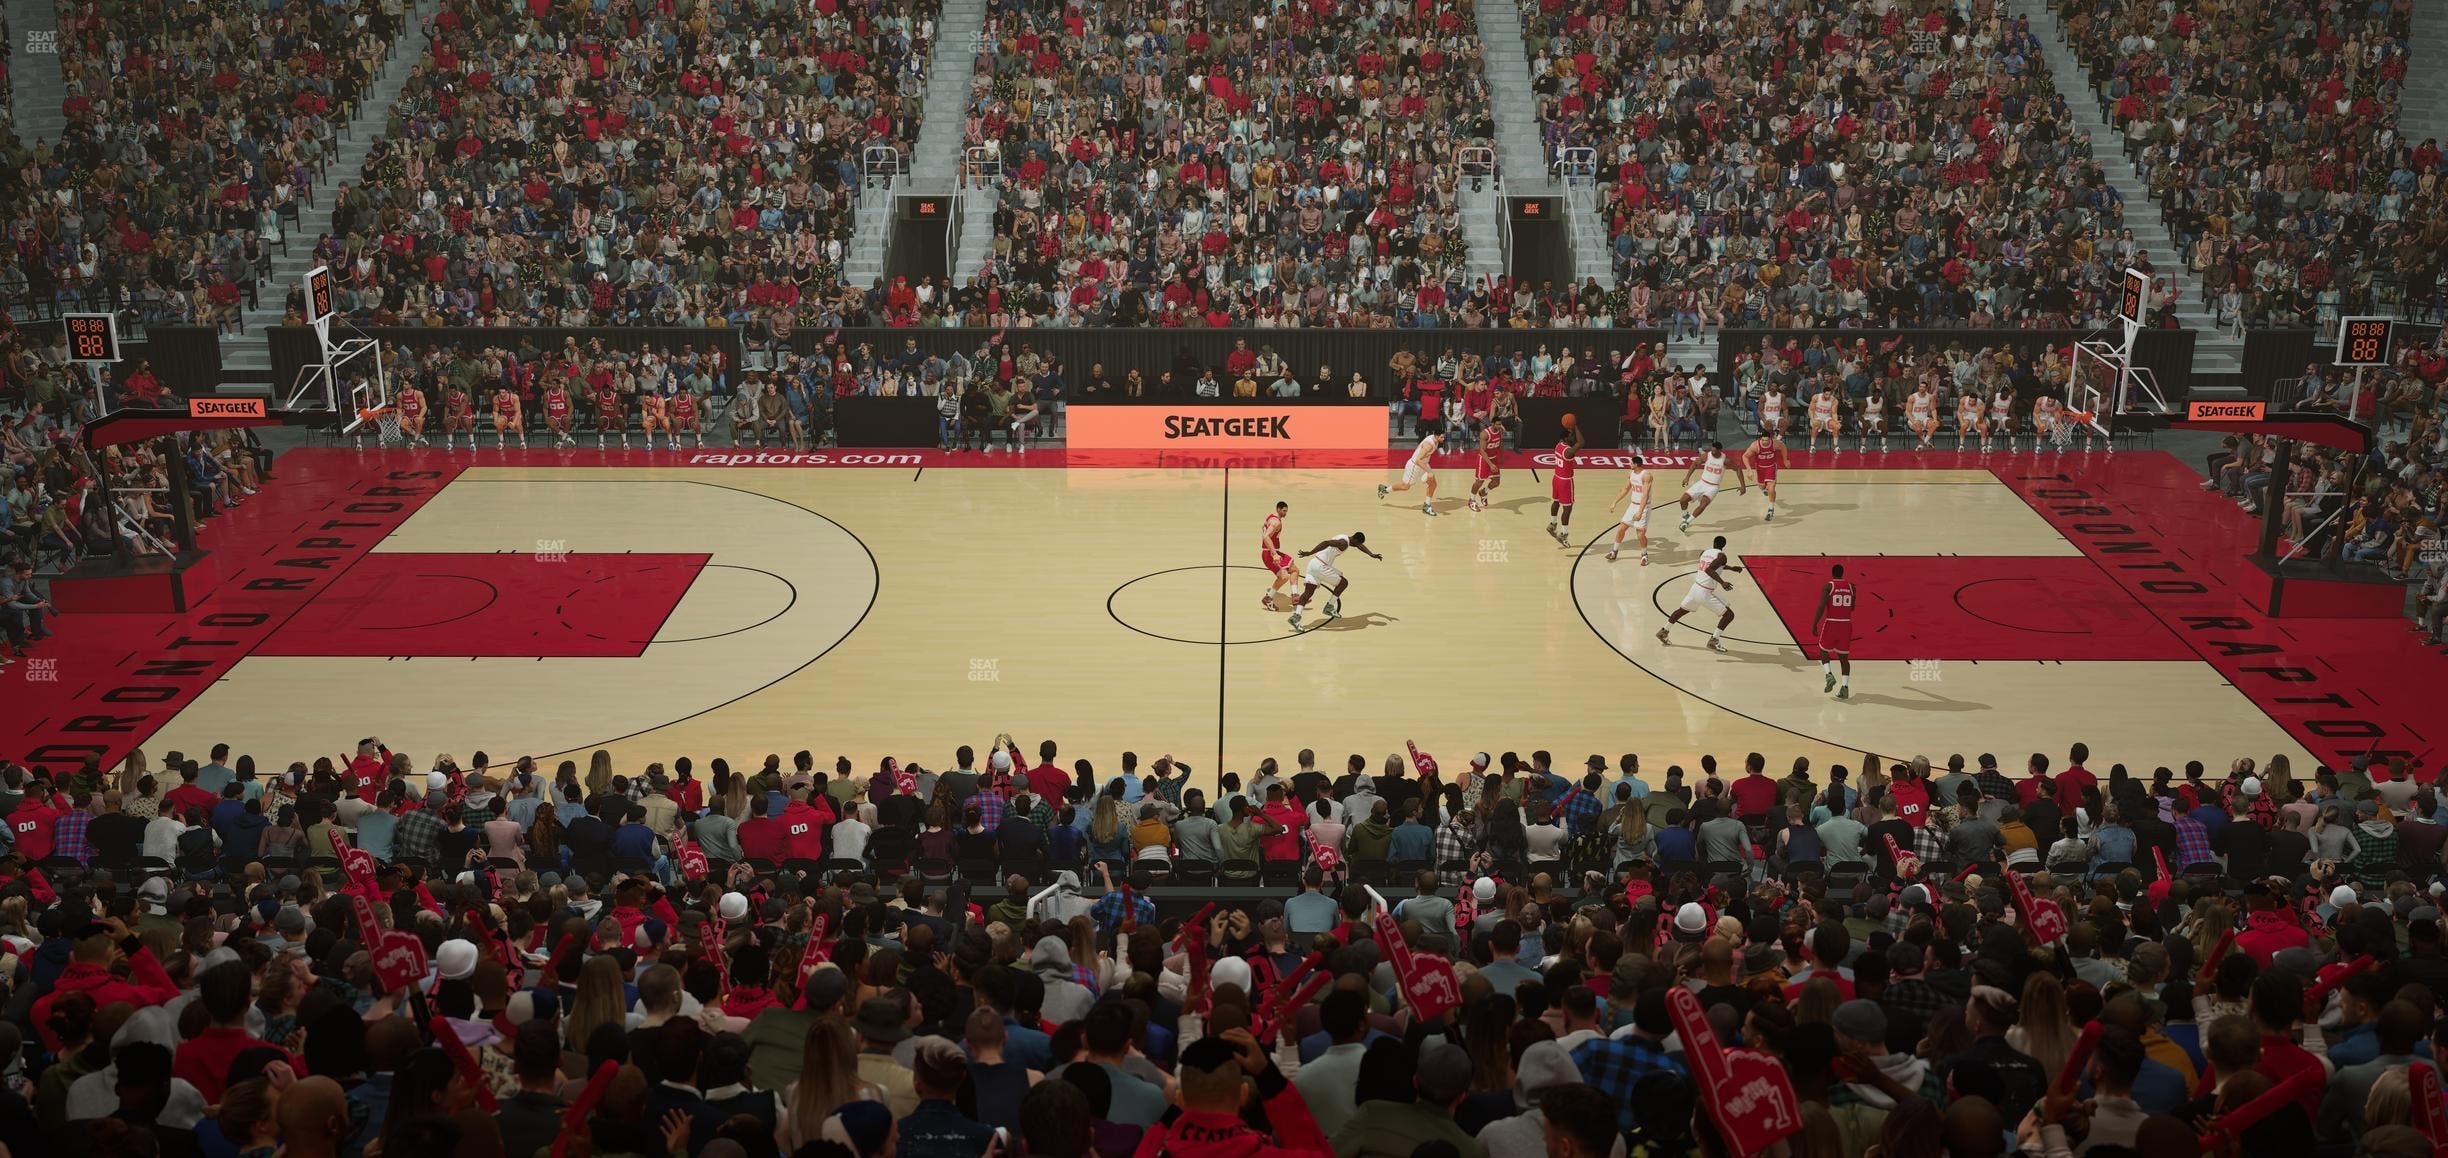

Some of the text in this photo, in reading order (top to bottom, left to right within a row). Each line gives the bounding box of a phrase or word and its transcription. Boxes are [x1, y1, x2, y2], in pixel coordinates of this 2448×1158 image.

[316, 290, 328, 314] 88
[2125, 293, 2137, 317] 88
[71, 319, 104, 333] 88 88
[2351, 323, 2385, 336] 88 88
[78, 335, 105, 357] 88
[2351, 338, 2378, 361] 88
[197, 402, 257, 414] SEATGEEK
[2197, 405, 2256, 417] SEATGEEK
[1164, 415, 1291, 440] SEATGEEK
[689, 452, 923, 466] raptors.com
[1832, 594, 1852, 607] 00
[24, 470, 443, 763] ORONTO RAPTORS
[2016, 474, 2426, 769] TORONTO RAPTOR
[1903, 804, 1919, 816] 00
[18, 821, 36, 833] 00
[790, 823, 808, 835] 00
